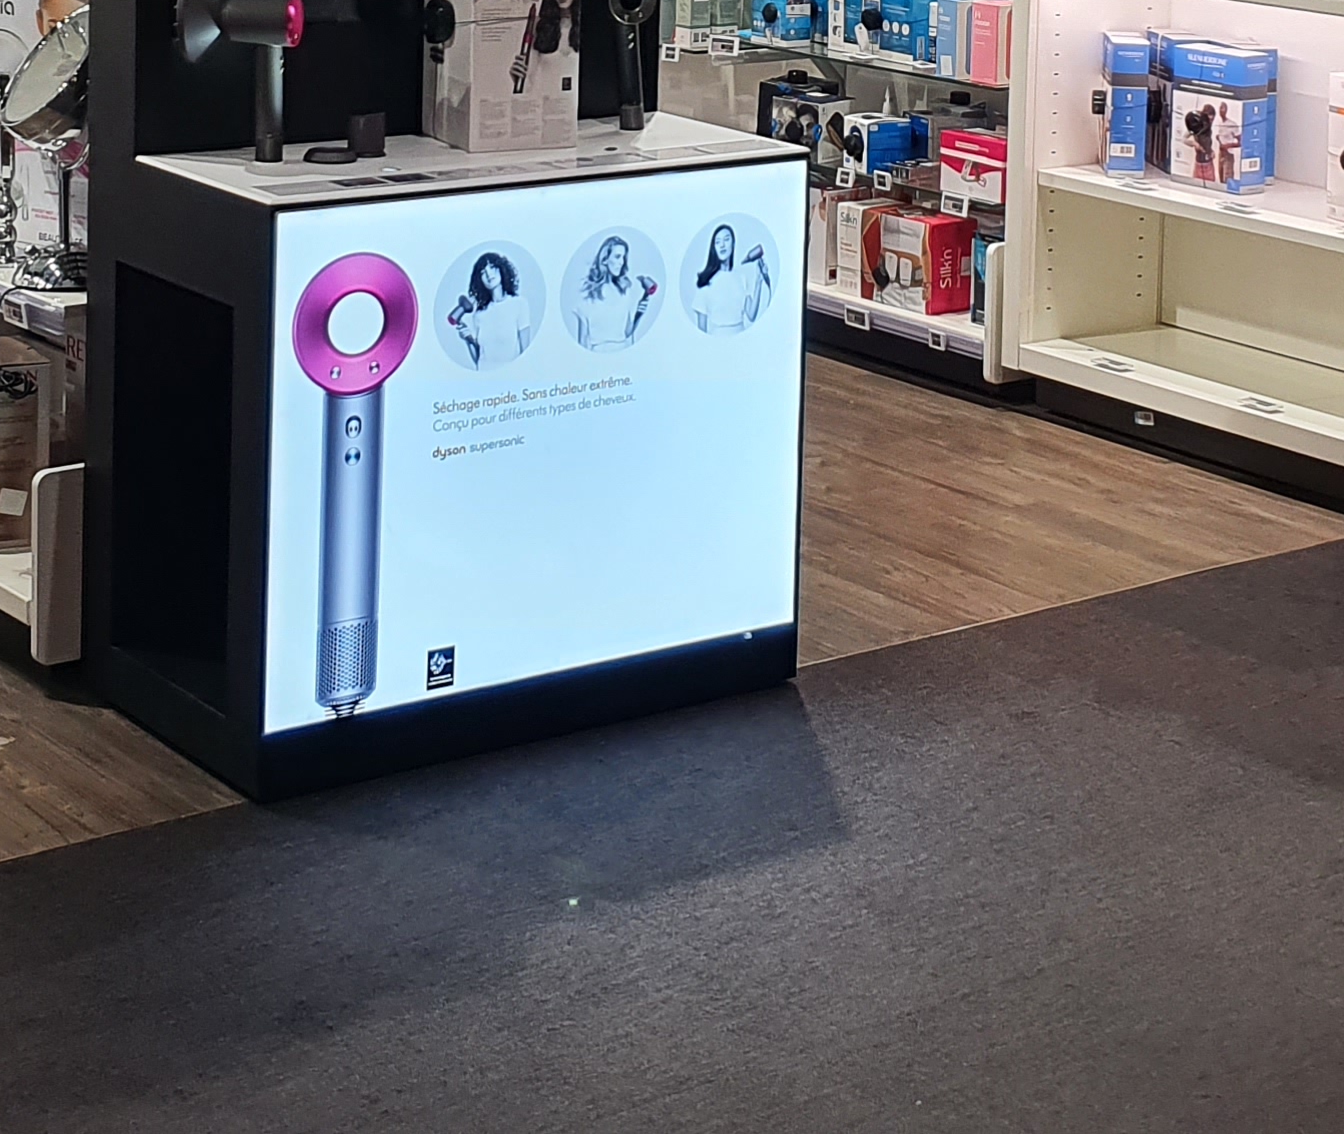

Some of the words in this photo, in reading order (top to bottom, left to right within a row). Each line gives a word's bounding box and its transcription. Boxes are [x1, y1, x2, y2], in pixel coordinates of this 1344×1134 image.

[432, 399, 481, 415] Séchage
[482, 391, 520, 410] rapide.
[522, 388, 548, 402] Sans
[549, 382, 588, 398] chaleur
[589, 375, 633, 391] extrême.
[432, 417, 469, 433] Conçu
[470, 413, 497, 430] pour
[498, 402, 547, 422] différents
[548, 401, 577, 418] types
[578, 395, 592, 411] de
[593, 392, 637, 409] cheveux.
[431, 444, 467, 461] dyson
[469, 434, 525, 454] supersonic
